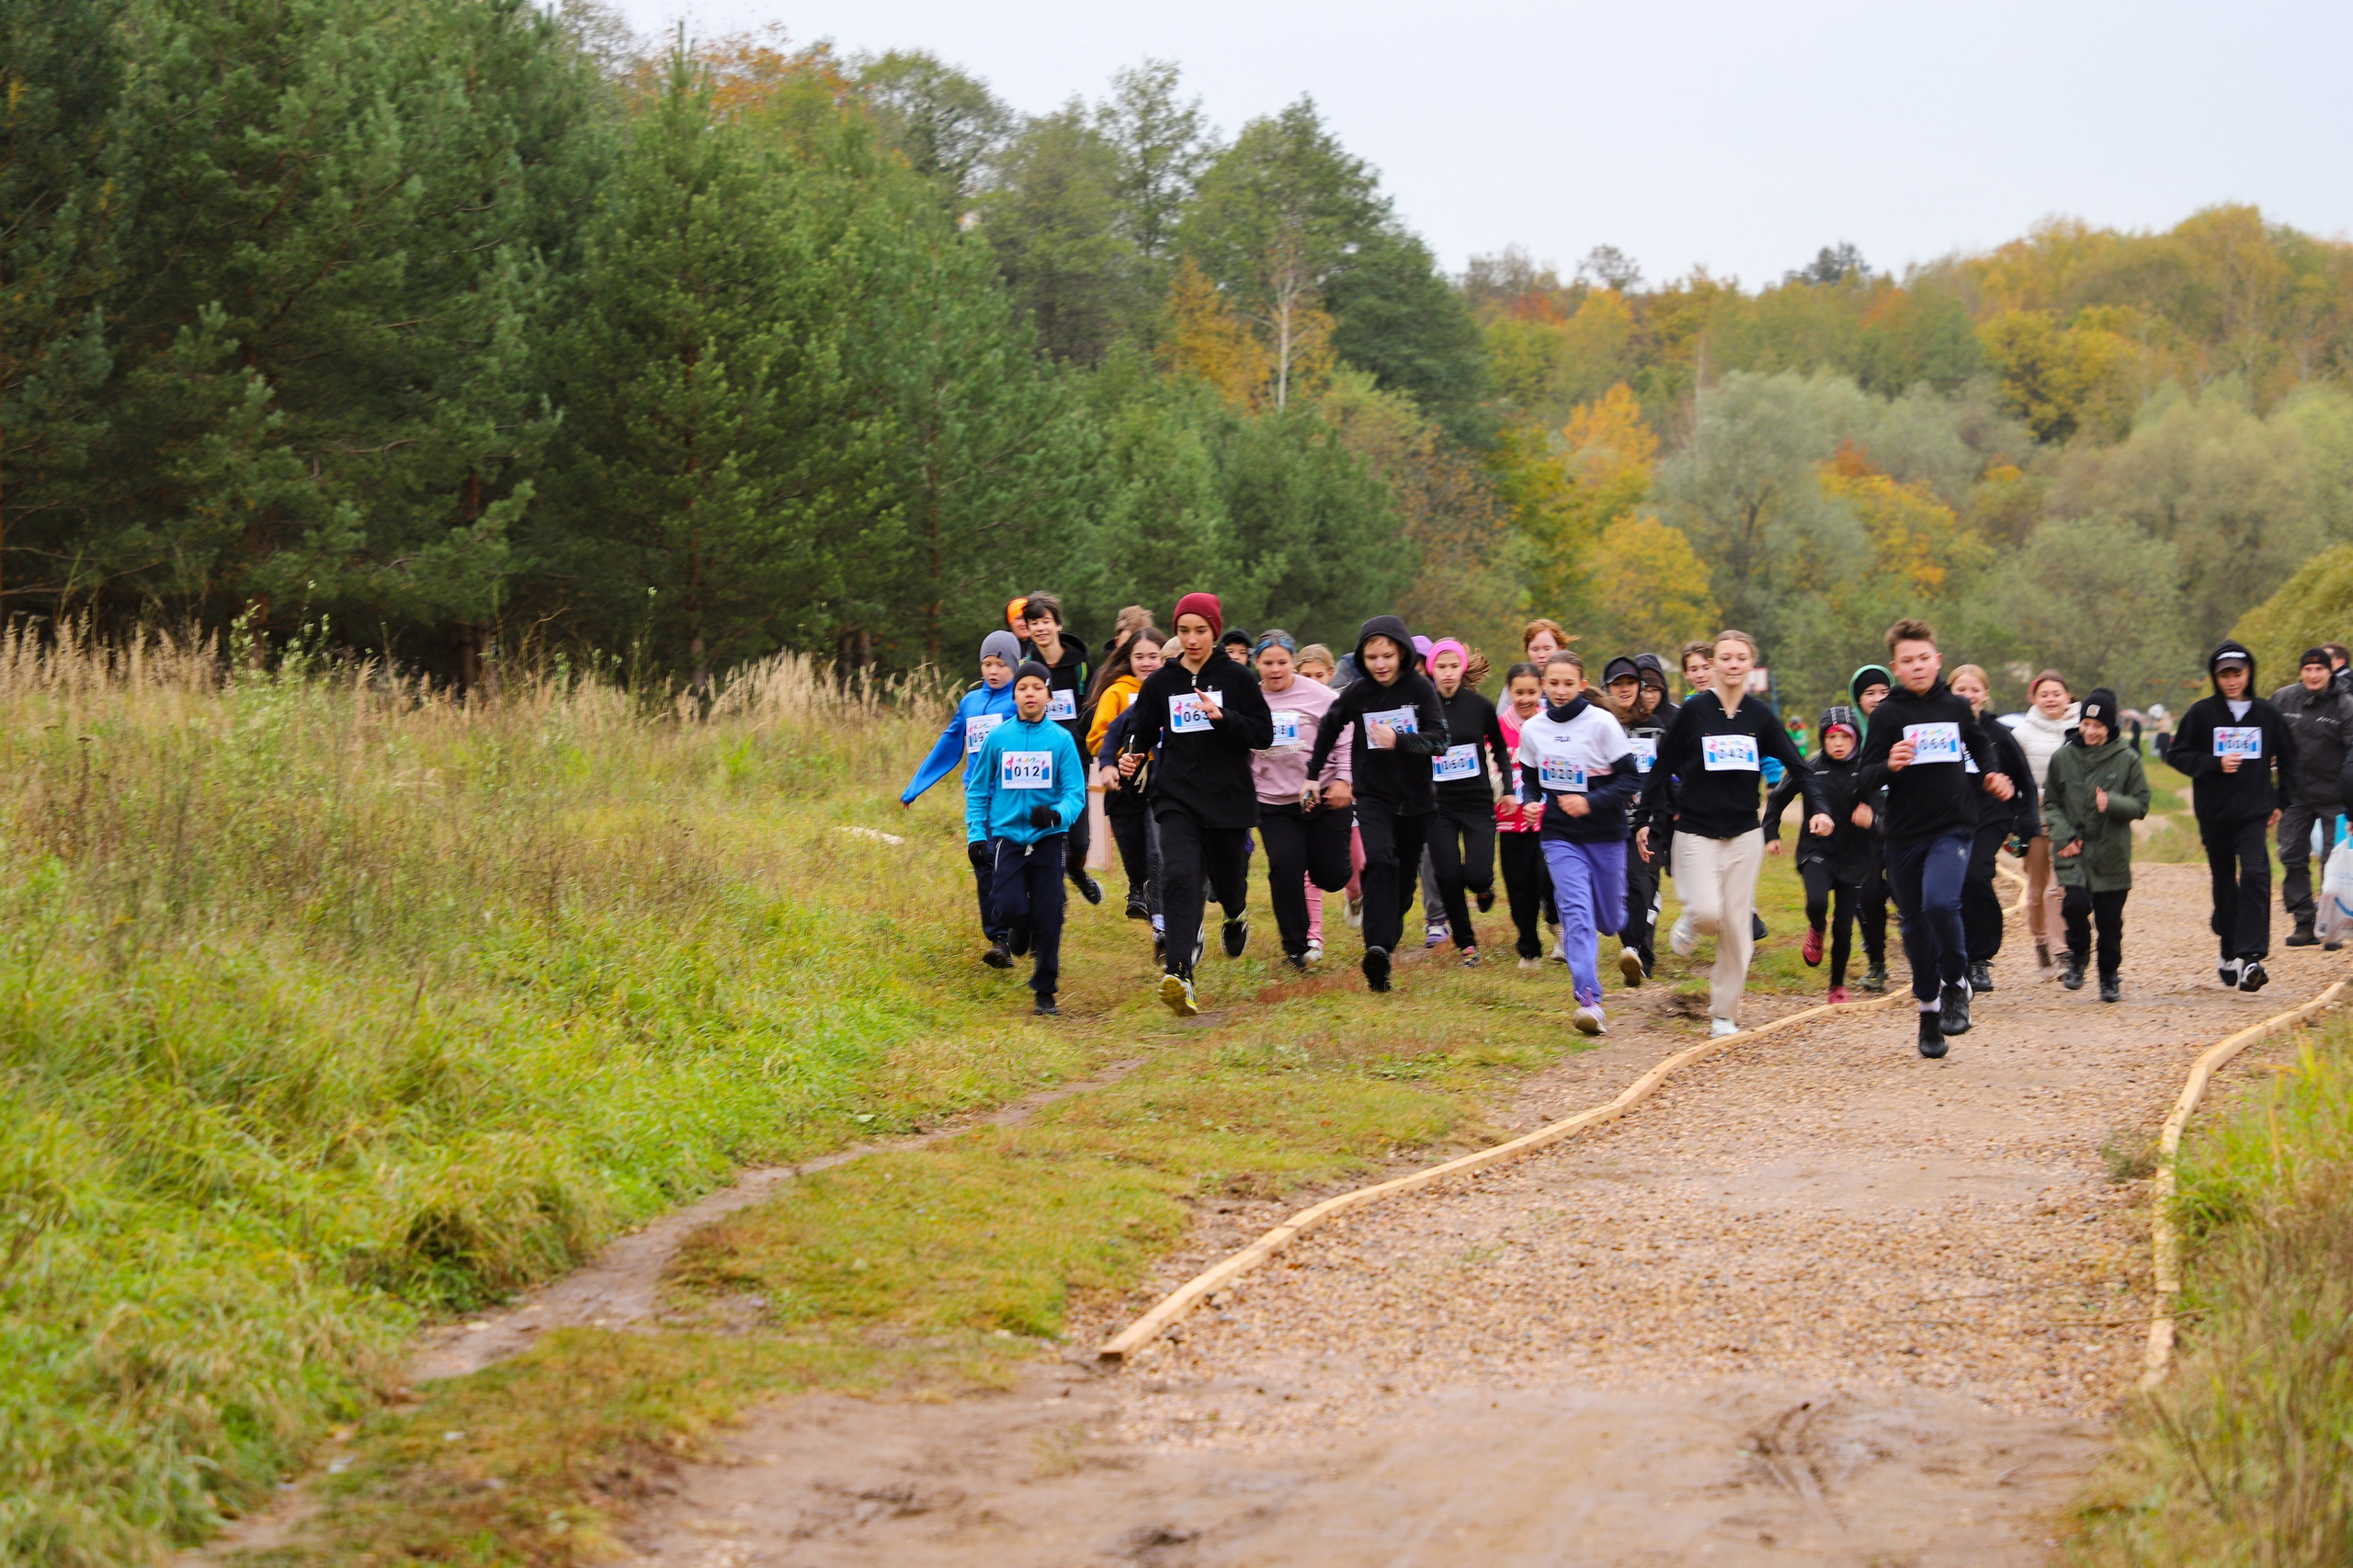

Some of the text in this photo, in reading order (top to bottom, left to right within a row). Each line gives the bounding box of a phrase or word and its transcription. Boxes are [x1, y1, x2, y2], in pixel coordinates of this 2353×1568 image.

[1183, 710, 1210, 722] 063
[1918, 737, 1949, 751] 066
[1014, 766, 1040, 778] 012
